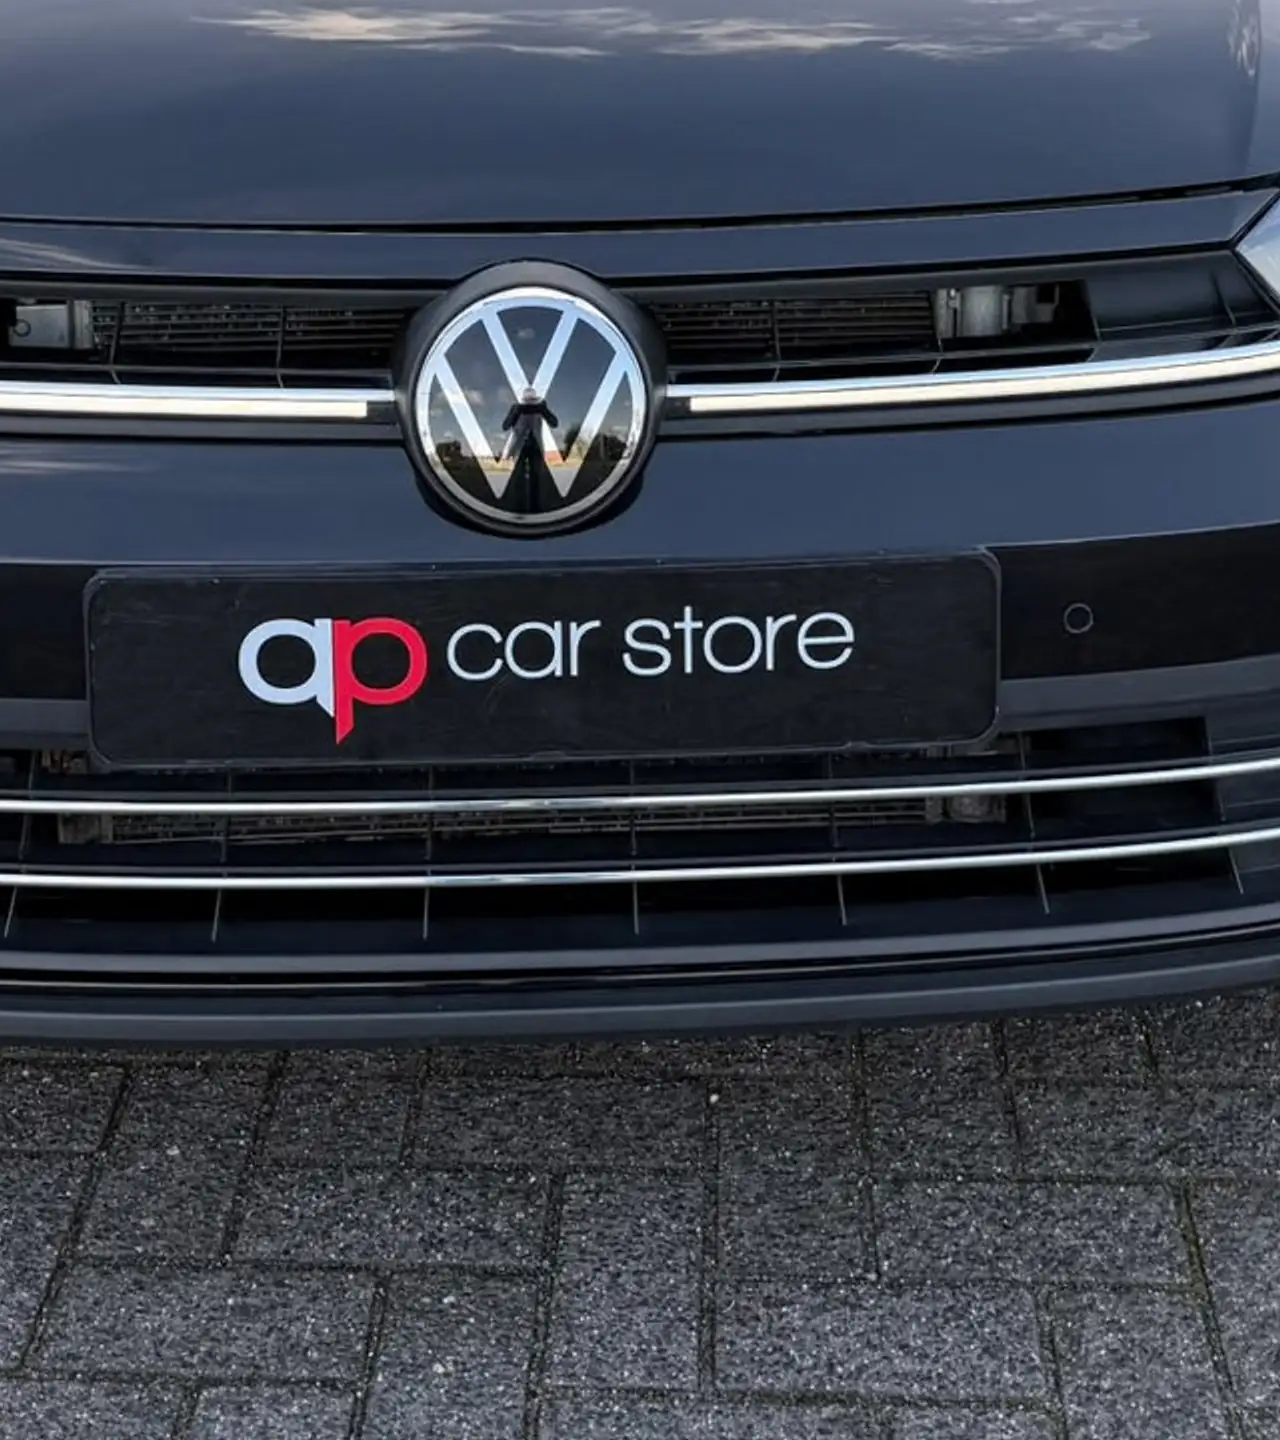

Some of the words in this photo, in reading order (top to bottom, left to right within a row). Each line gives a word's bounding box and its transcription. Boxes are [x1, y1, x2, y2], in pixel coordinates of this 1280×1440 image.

[238, 617, 428, 743] ap
[447, 619, 601, 680] car
[622, 605, 855, 676] store
